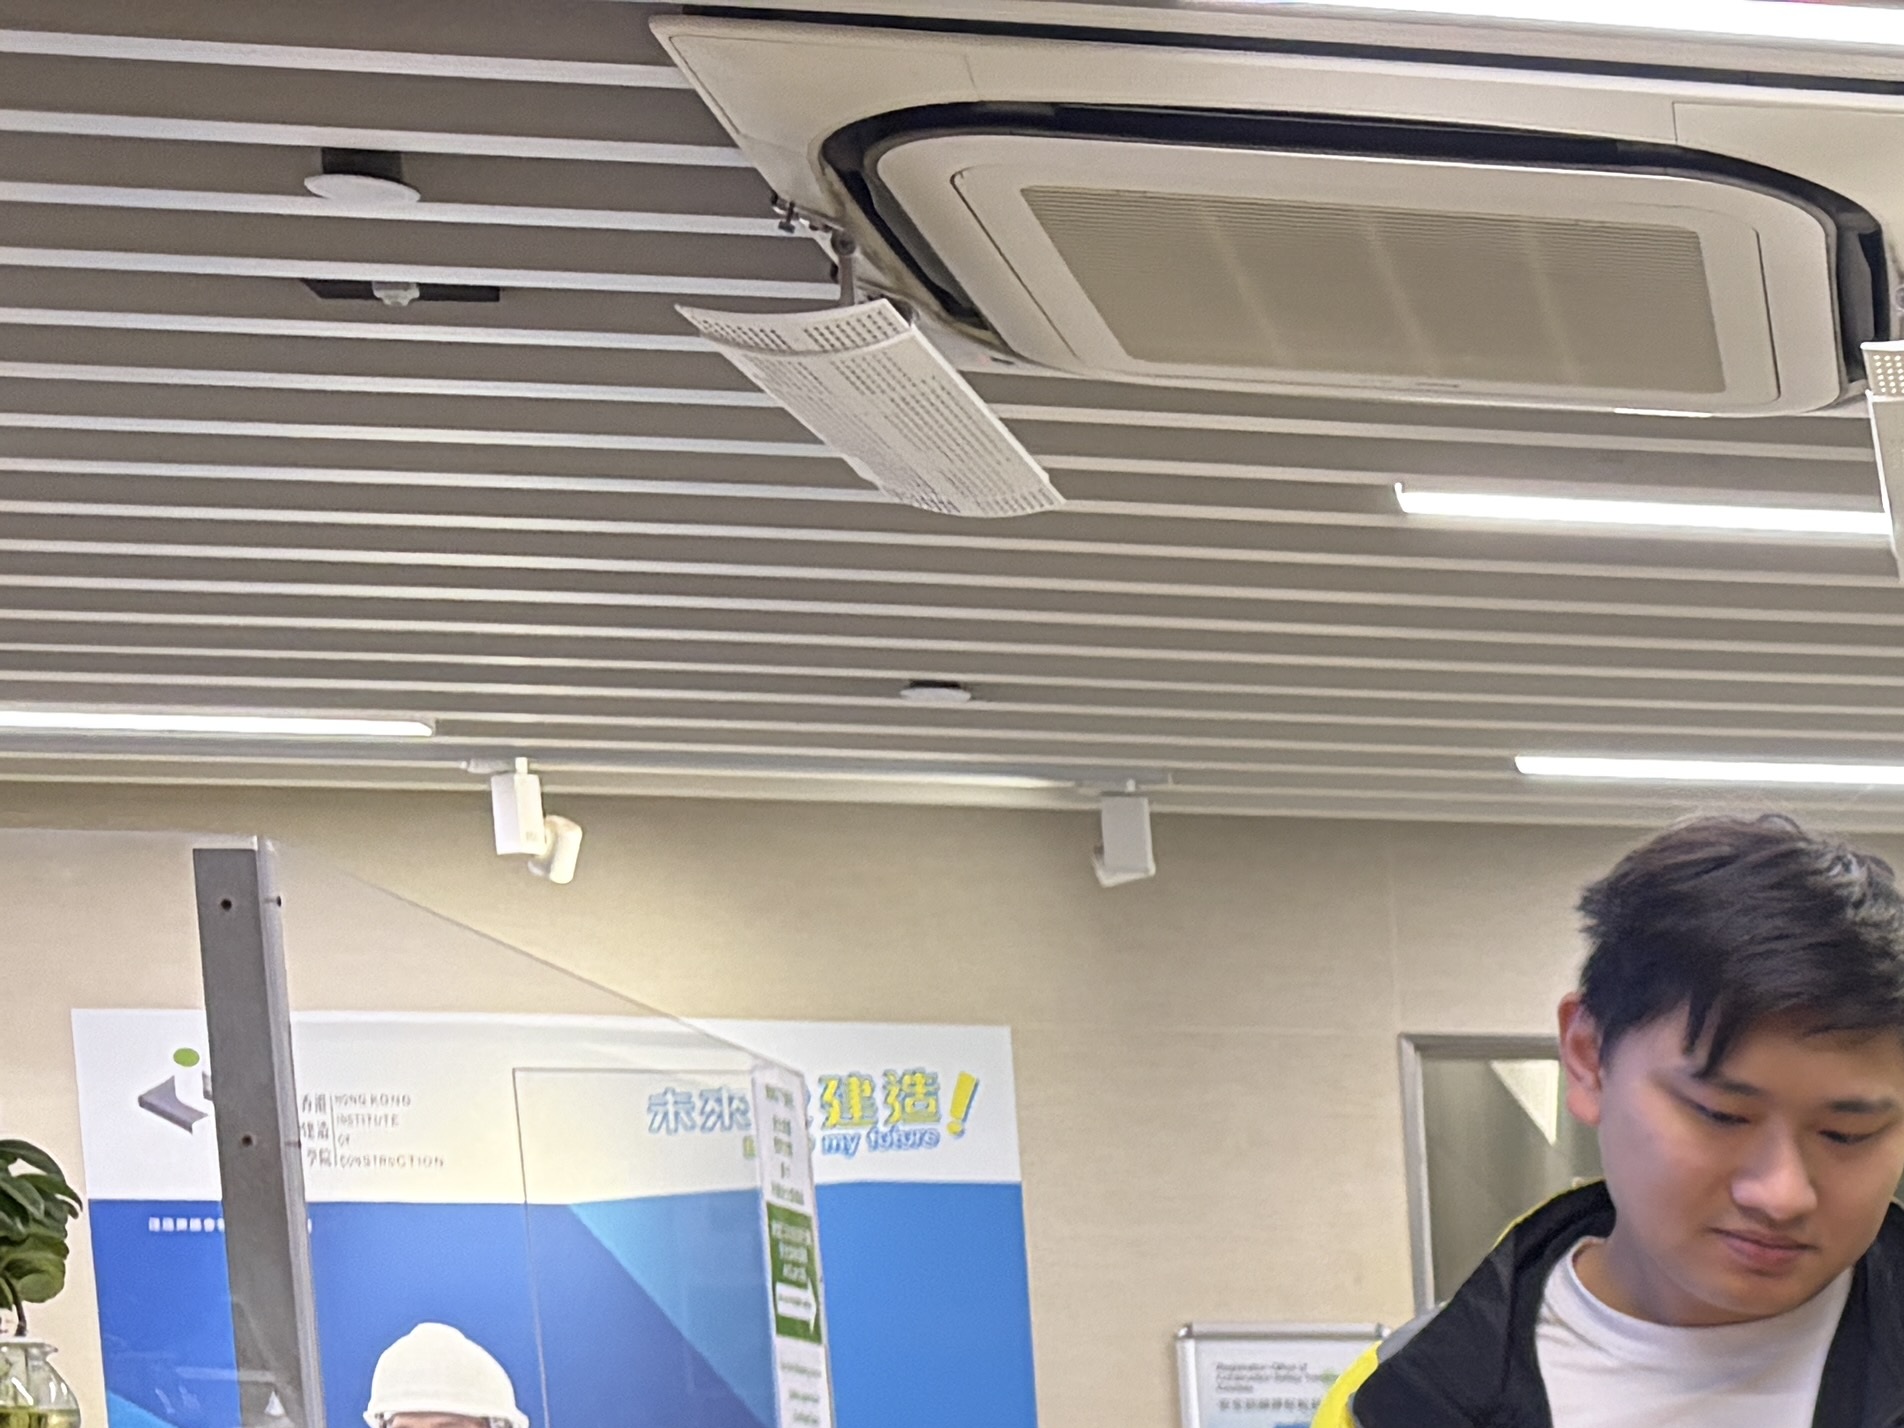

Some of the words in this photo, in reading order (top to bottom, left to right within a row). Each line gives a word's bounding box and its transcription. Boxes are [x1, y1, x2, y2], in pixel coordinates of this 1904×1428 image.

[647, 1067, 980, 1139] 未來建造!
[822, 1131, 861, 1159] my
[866, 1124, 941, 1151] future
